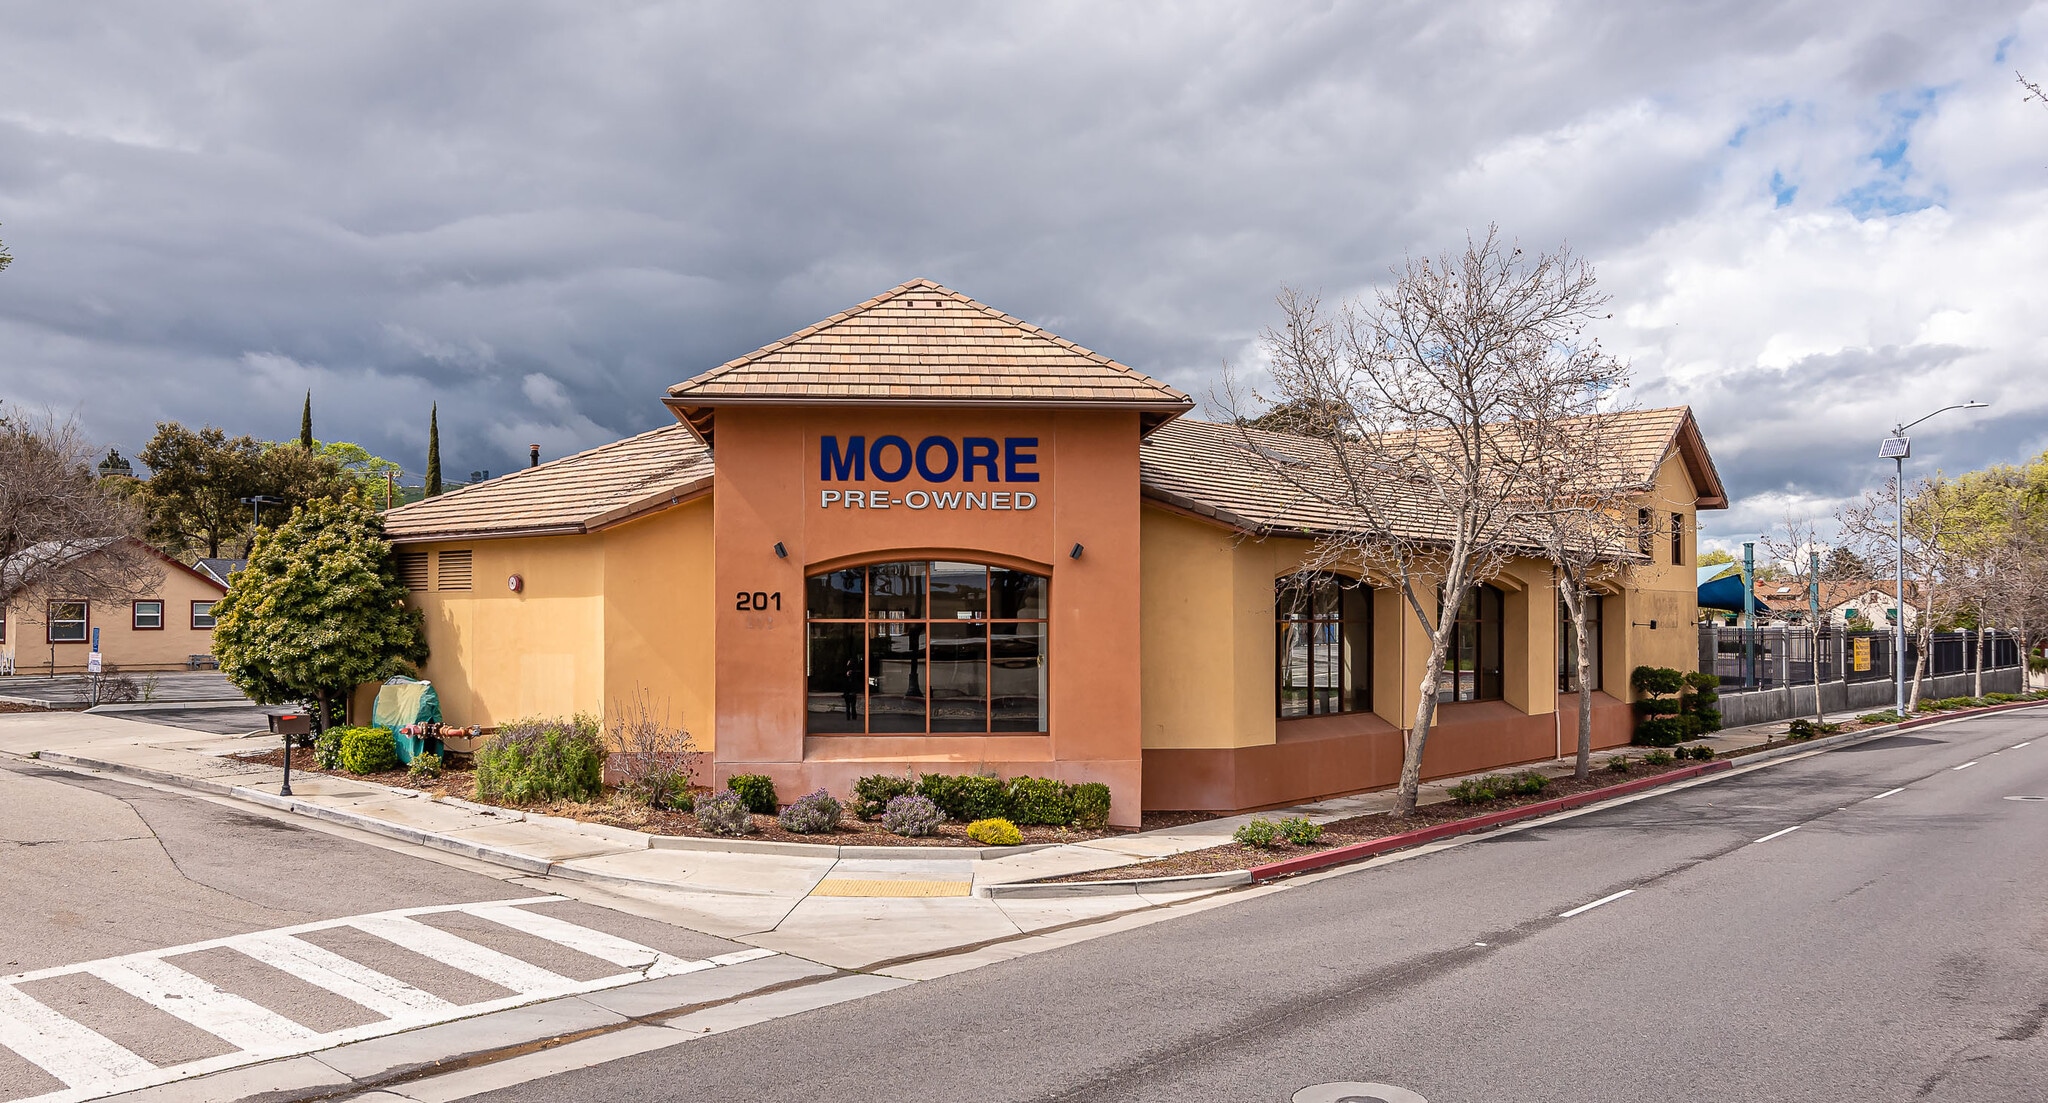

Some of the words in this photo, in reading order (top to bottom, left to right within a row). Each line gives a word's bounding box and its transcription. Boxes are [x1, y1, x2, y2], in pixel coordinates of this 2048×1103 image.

[820, 435, 1040, 483] MOORE
[820, 489, 1038, 511] PRE-OWNED
[736, 591, 781, 611] 201
